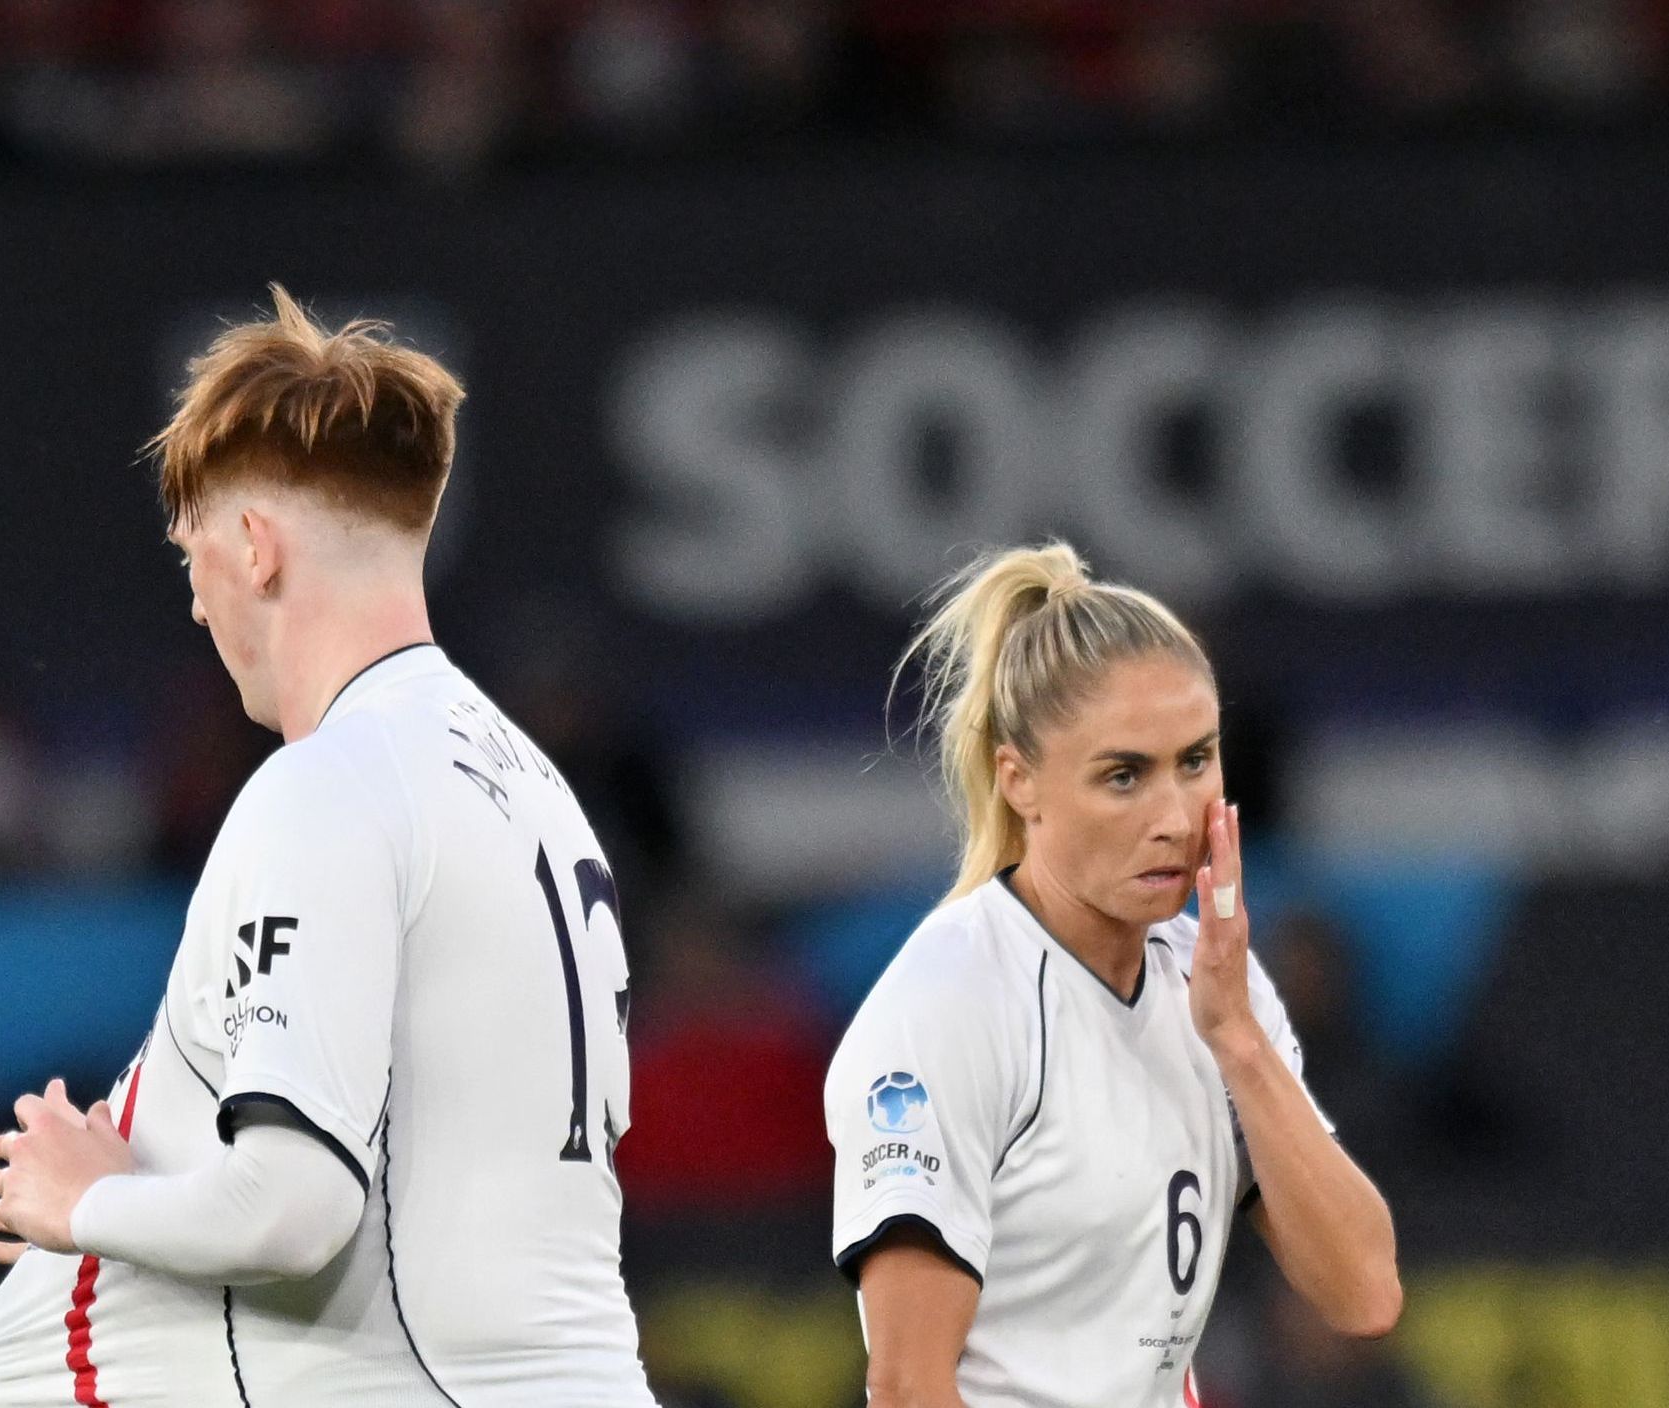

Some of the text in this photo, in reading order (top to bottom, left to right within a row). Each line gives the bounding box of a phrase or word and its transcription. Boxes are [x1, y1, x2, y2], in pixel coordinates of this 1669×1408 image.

[862, 1143, 909, 1172] SOCCER
[914, 1150, 940, 1172] AID
[1168, 1170, 1202, 1295] 6
